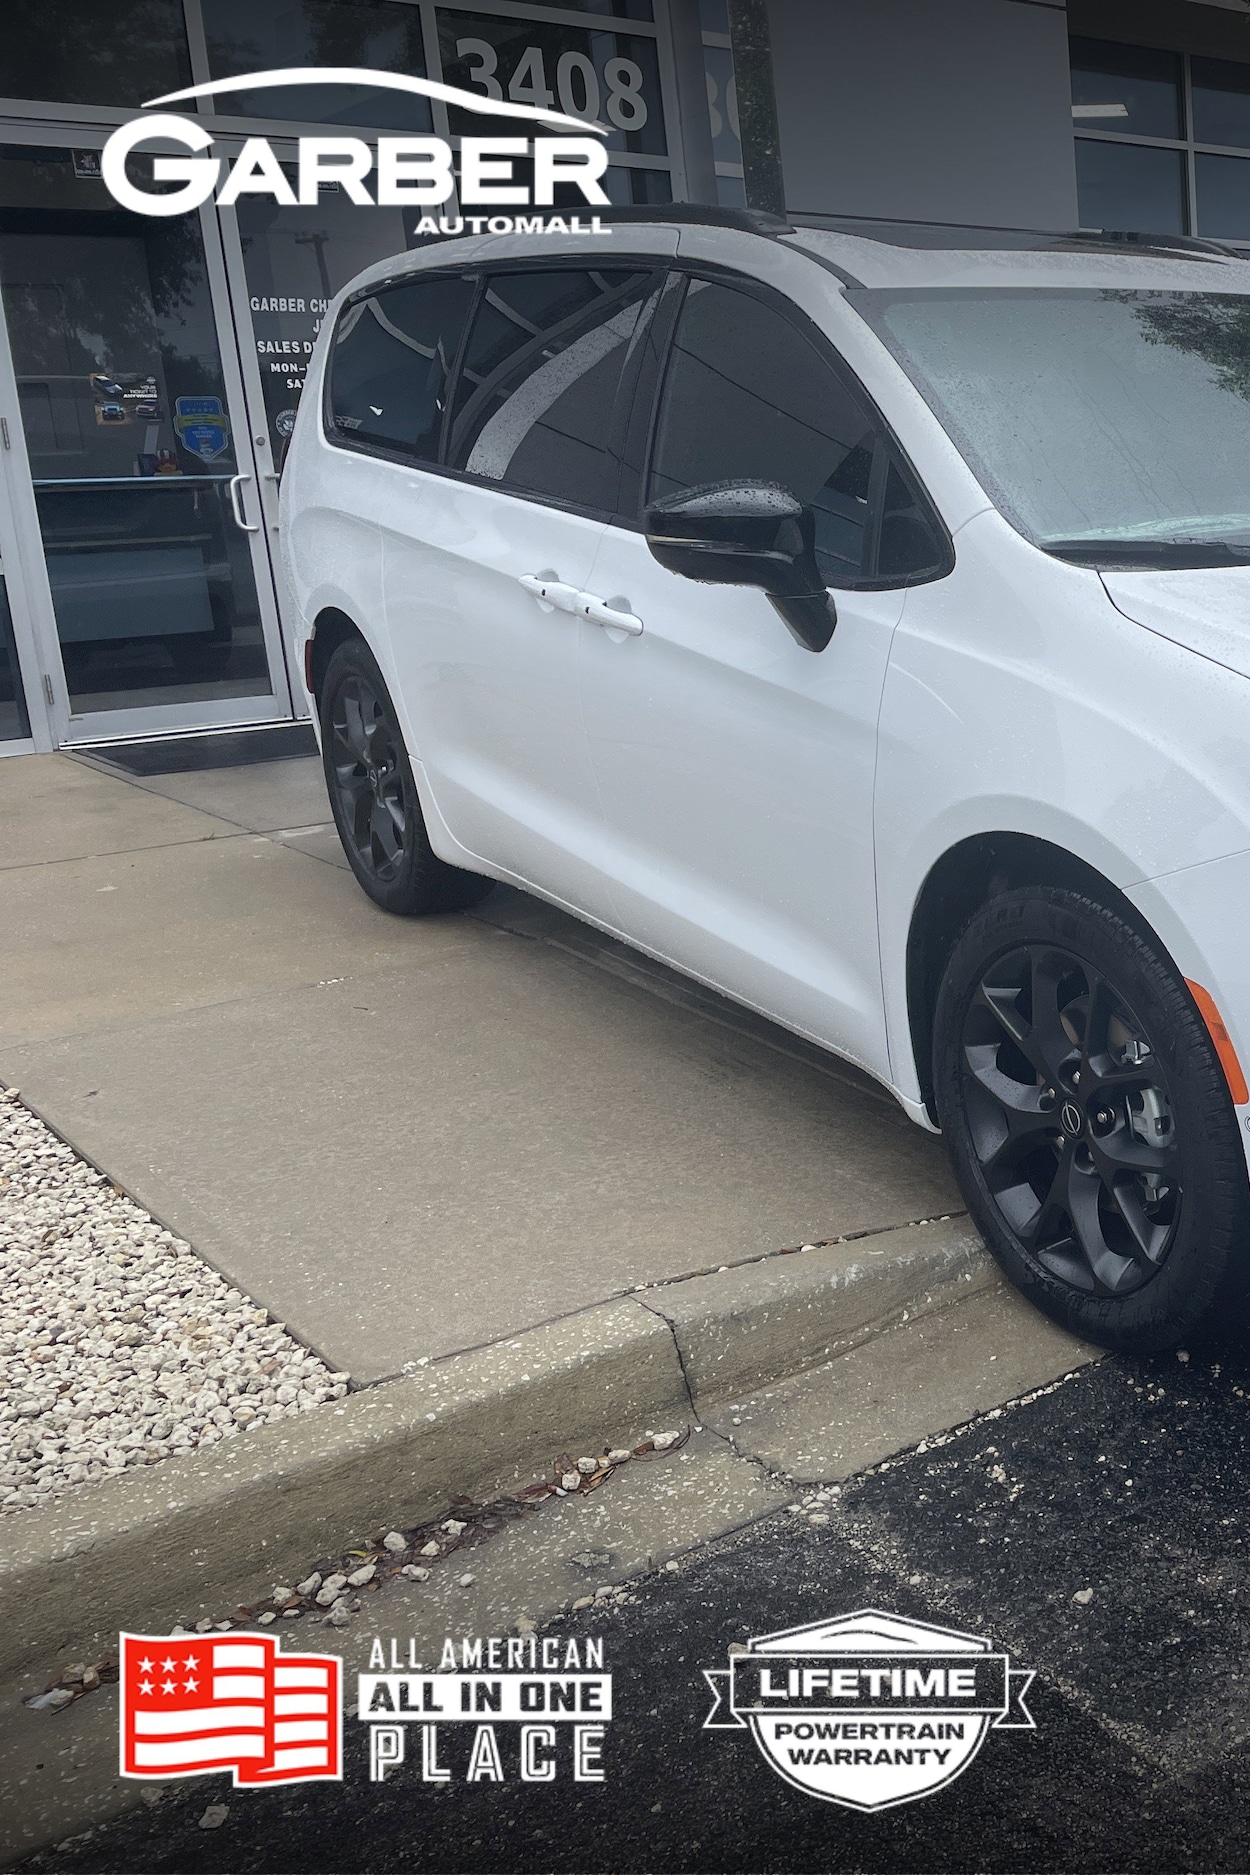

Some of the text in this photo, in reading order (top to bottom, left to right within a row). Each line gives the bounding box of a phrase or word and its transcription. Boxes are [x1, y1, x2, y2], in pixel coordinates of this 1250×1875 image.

[456, 38, 648, 132] 3408
[250, 297, 306, 313] GARBER
[257, 341, 300, 354] SALES
